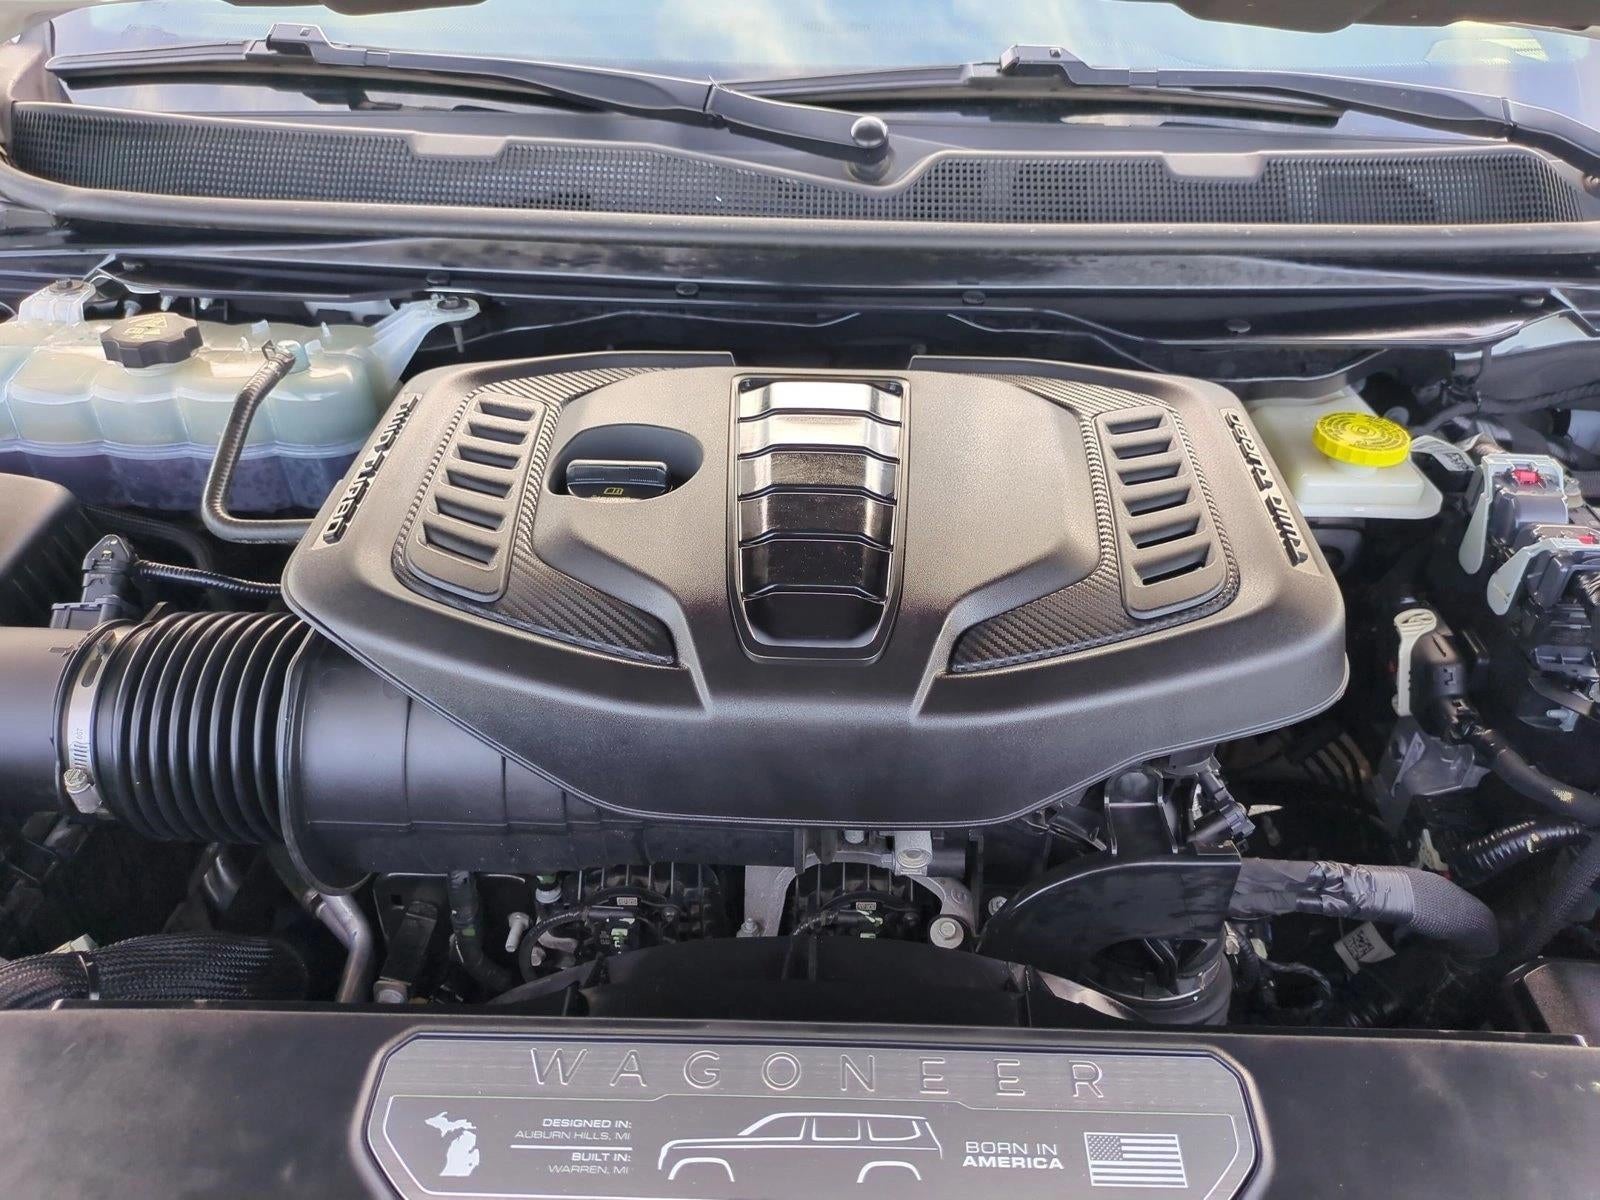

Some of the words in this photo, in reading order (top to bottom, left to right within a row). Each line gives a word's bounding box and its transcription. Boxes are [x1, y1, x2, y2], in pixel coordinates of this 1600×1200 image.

[323, 452, 386, 544] TURBO
[531, 1048, 1104, 1098] WAGONEER
[542, 1118, 611, 1128] DESIGNED
[614, 1120, 632, 1129] IN:
[514, 1130, 571, 1141] AUBURN
[573, 1131, 612, 1142] HILLS,
[615, 1132, 630, 1141] MI
[965, 1141, 1027, 1154] BORN
[1037, 1144, 1057, 1155] IN
[571, 1152, 610, 1162] BUILT
[613, 1153, 632, 1163] IN:
[962, 1156, 1064, 1170] AMERICA
[548, 1165, 611, 1176] WARREN,
[613, 1166, 629, 1175] MI
